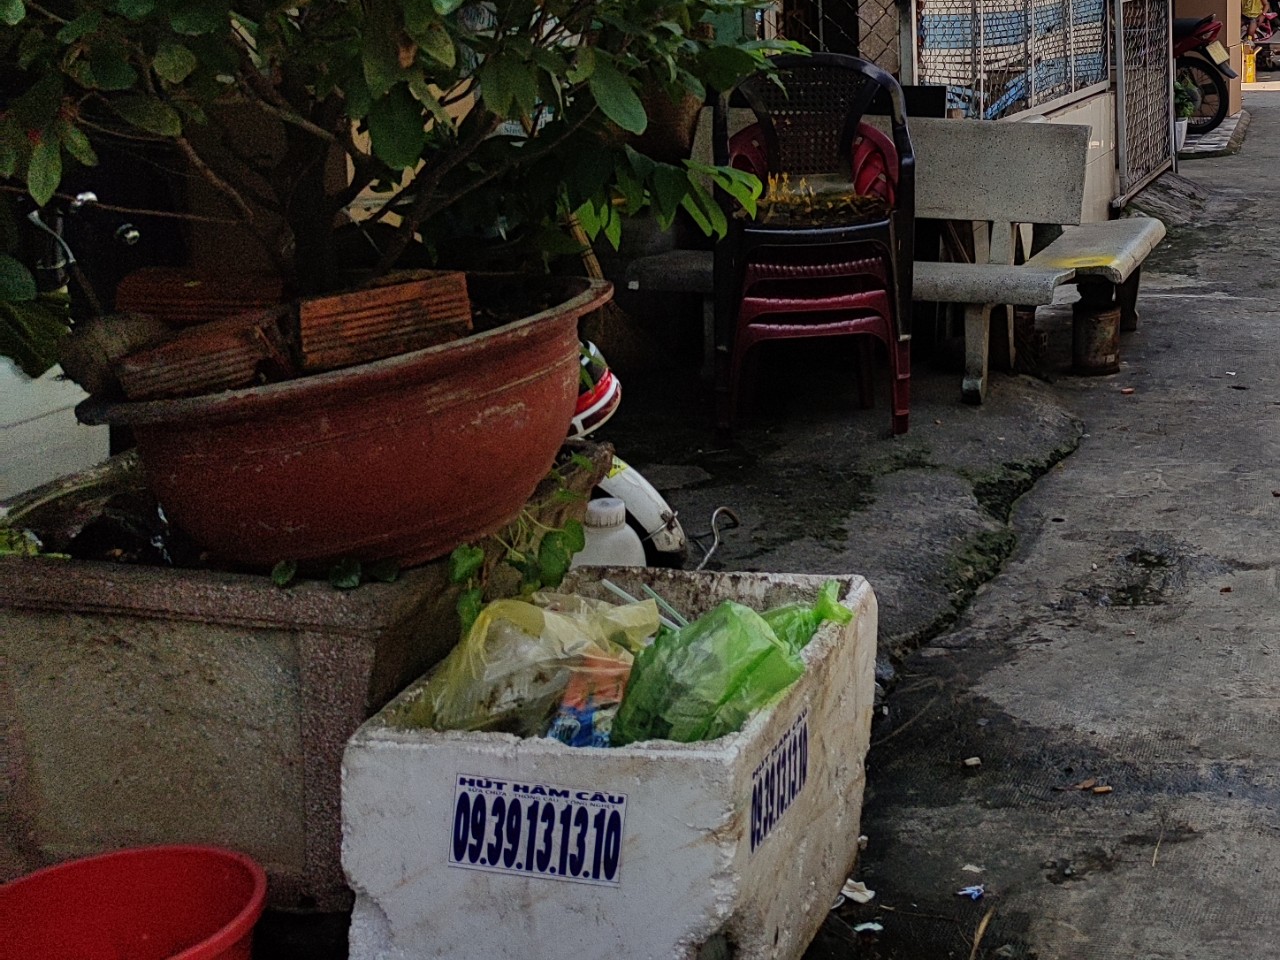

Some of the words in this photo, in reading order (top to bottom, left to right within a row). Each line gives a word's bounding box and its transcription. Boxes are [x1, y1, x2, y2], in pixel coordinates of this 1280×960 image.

[459, 777, 508, 791] HÚT
[513, 784, 570, 799] HẦM
[575, 790, 625, 805] CẦU
[453, 791, 622, 881] 09.39.13.13.10
